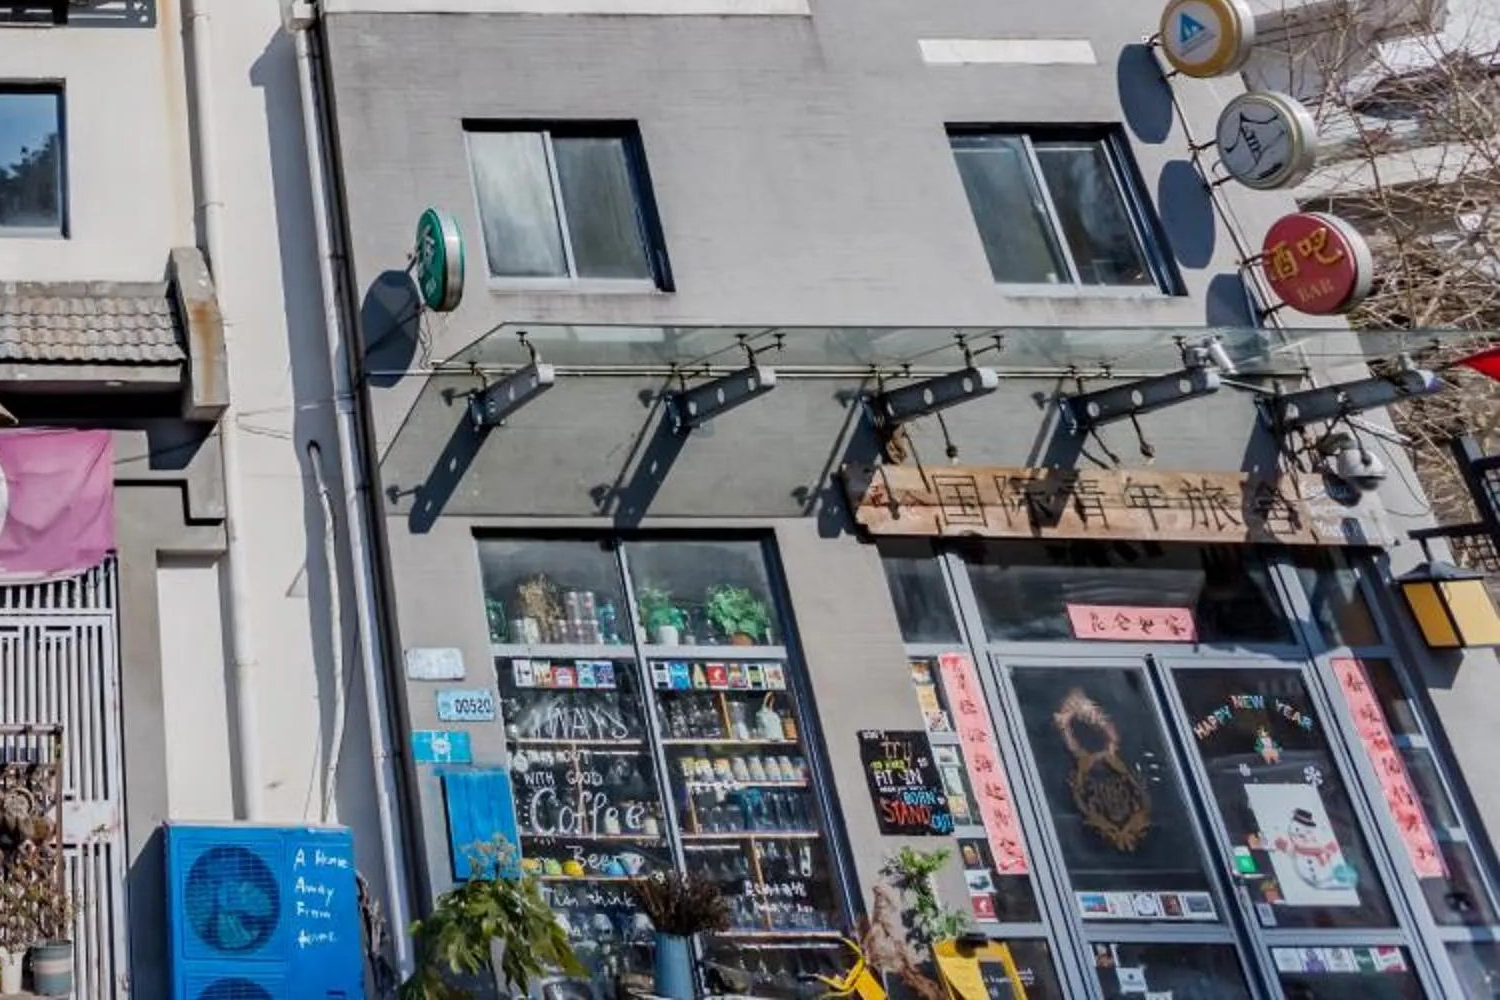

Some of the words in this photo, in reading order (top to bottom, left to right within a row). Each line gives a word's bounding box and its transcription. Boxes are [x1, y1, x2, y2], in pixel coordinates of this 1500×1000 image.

[1270, 226, 1345, 282] 酒吧
[1296, 277, 1336, 302] BAR
[1193, 705, 1233, 740] HAPPY
[1229, 695, 1265, 710] NEW
[1275, 699, 1313, 731] YEAR
[524, 771, 556, 786] WITH
[293, 848, 306, 871] A
[295, 876, 334, 907] Away
[296, 901, 331, 919] From
